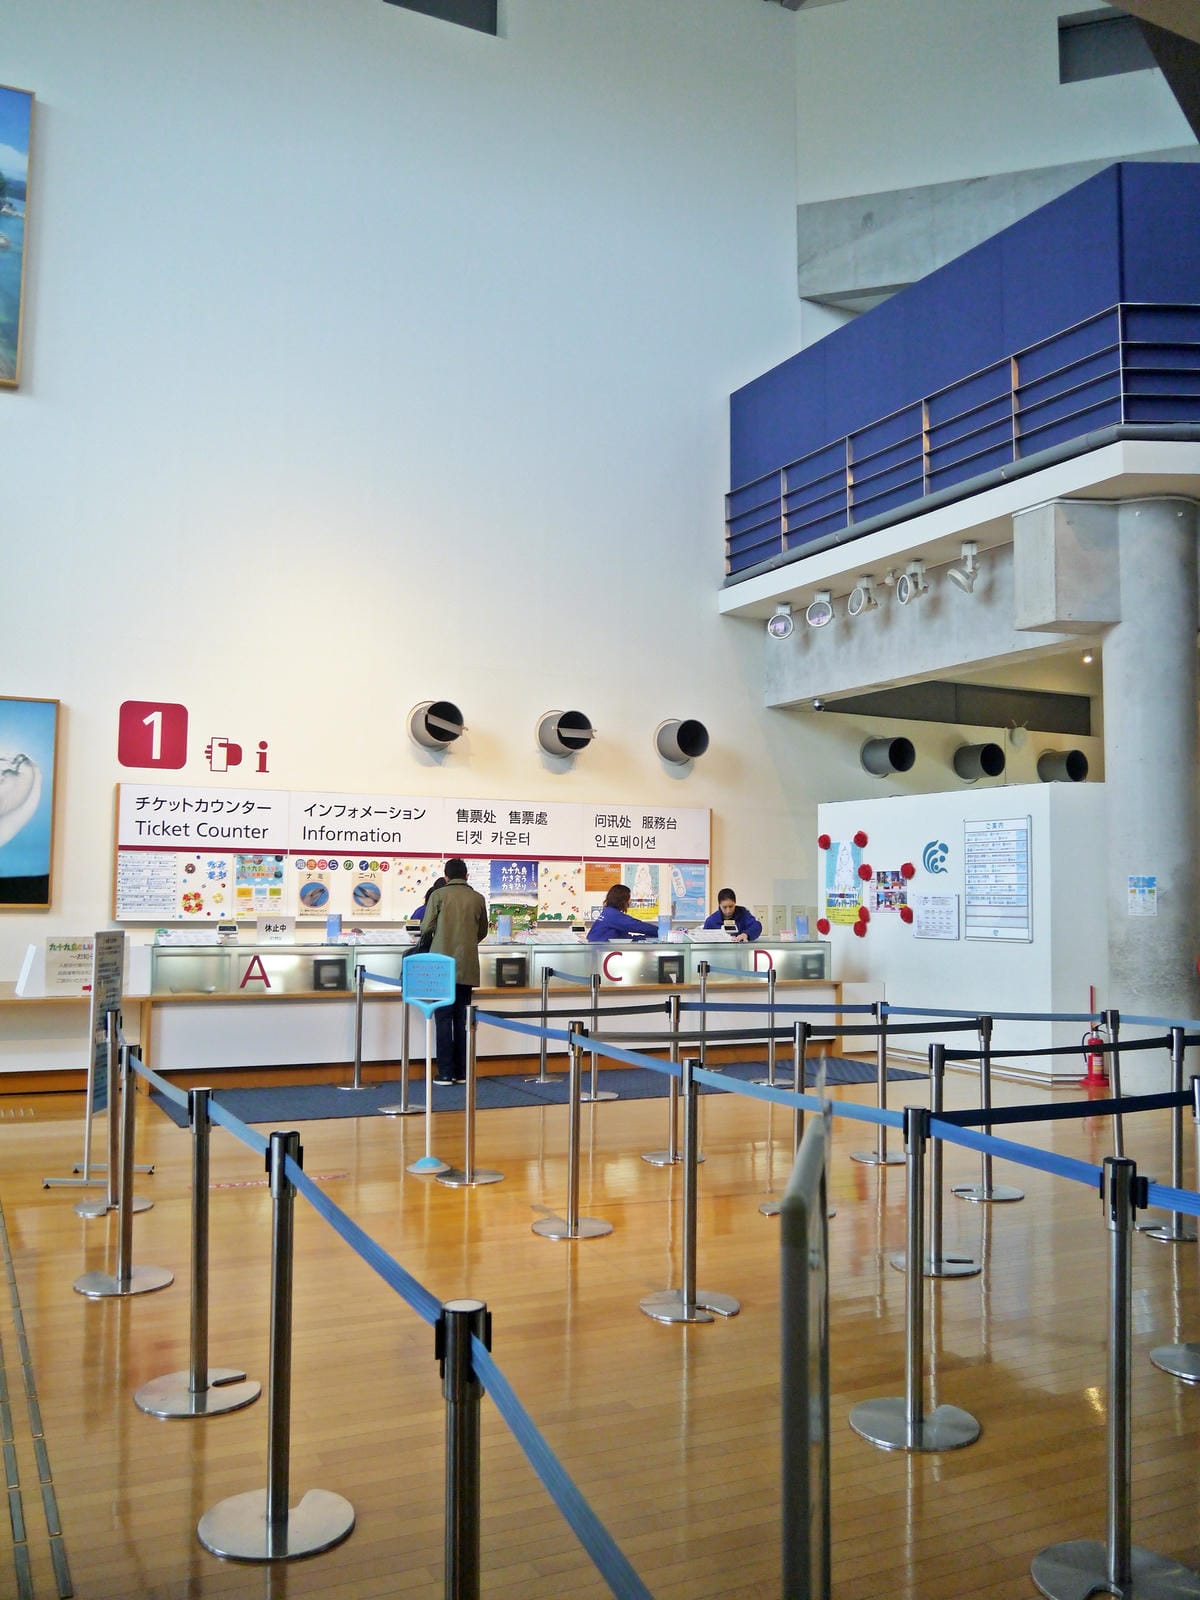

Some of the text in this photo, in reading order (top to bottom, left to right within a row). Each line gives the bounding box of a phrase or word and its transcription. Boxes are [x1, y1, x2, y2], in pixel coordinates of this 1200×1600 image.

[142, 711, 163, 760] 1
[135, 796, 272, 815] チケットカウンター
[303, 803, 427, 821] インフォメーション
[456, 808, 549, 826] 售票处 售票處
[594, 813, 678, 831] 问讯处 服務台
[135, 820, 269, 840] Ticket Counter
[302, 825, 402, 843] Information
[456, 829, 531, 847] 티켓 카운터
[594, 833, 657, 850] 인포메이션
[359, 860, 390, 872] イルカ
[264, 923, 287, 932] 休止中
[49, 943, 93, 952] 九十九島CLU
[602, 951, 623, 982] C
[753, 949, 774, 974] D
[239, 954, 272, 988] A
